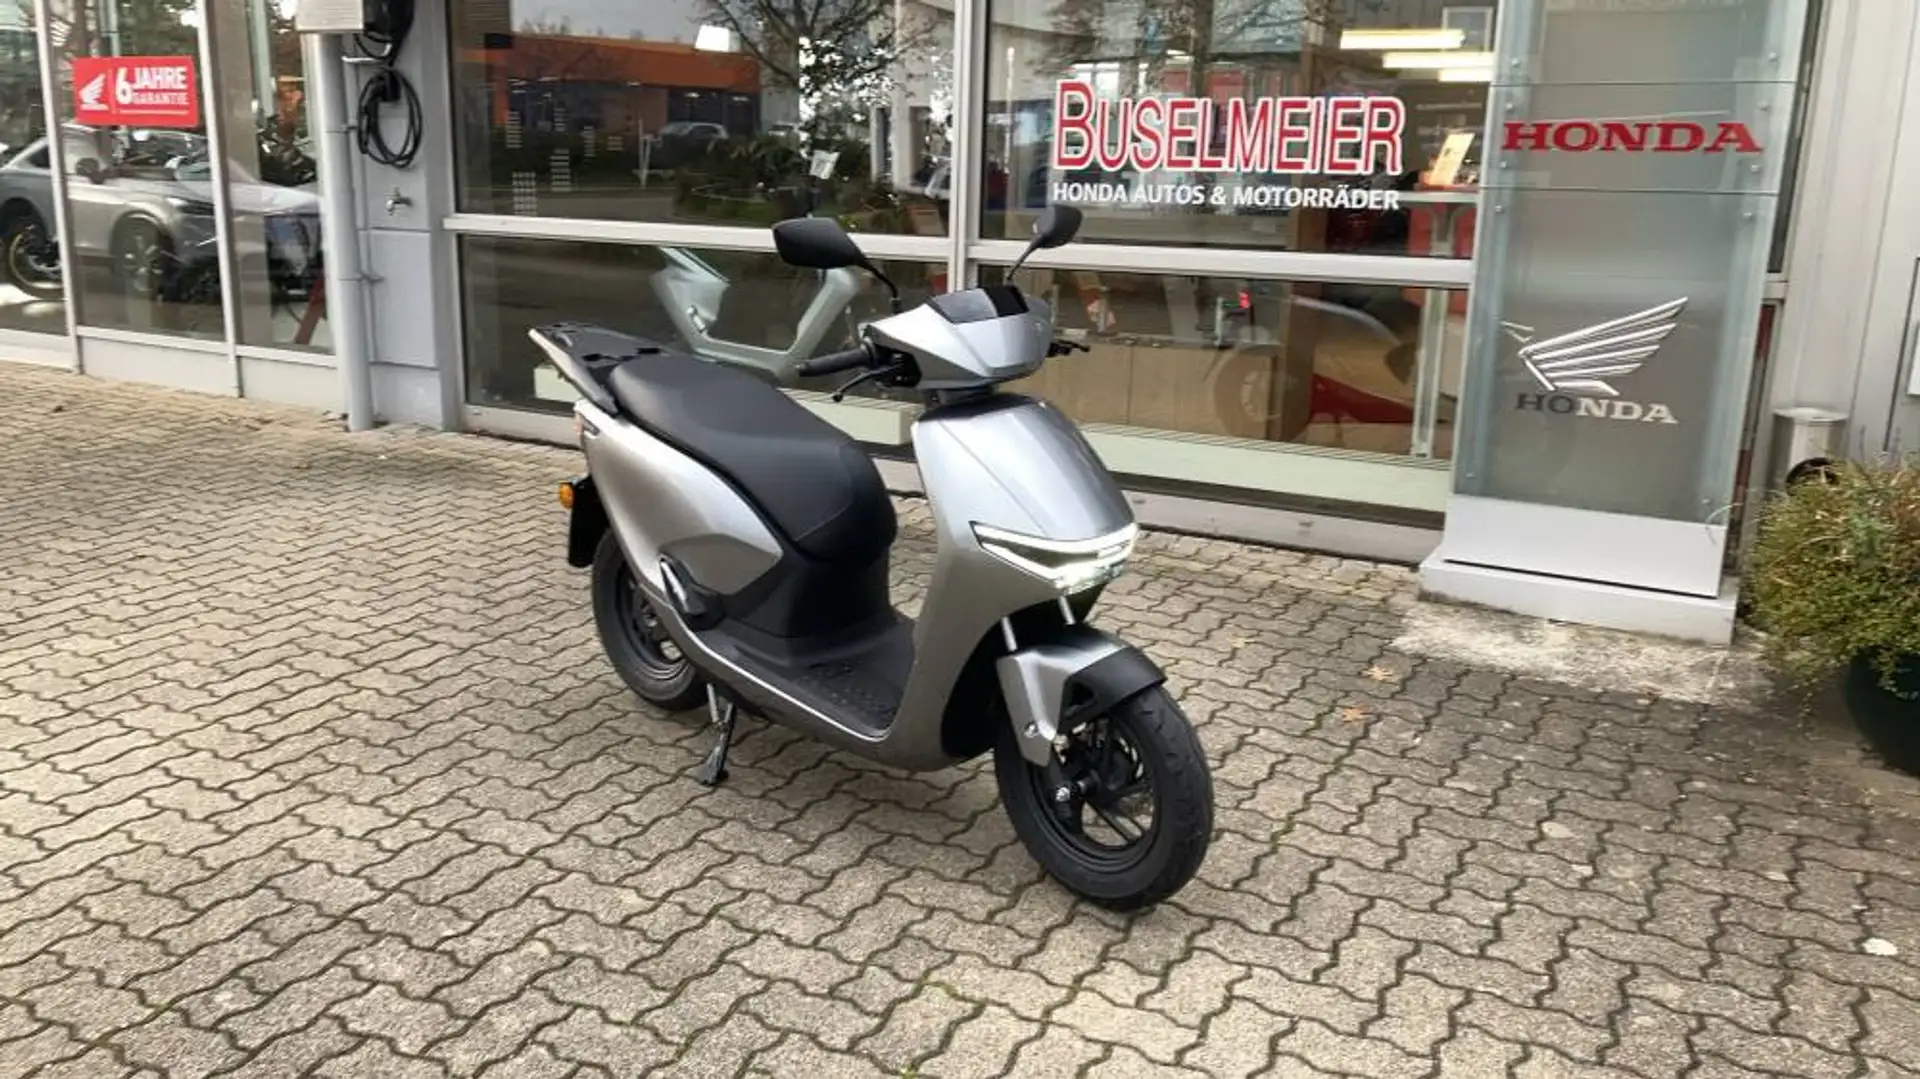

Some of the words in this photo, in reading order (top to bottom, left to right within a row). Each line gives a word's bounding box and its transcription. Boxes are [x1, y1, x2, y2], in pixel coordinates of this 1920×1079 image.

[115, 66, 133, 105] 6
[133, 66, 188, 89] JAHRE
[1053, 79, 1406, 176] BUSELMEIER
[1503, 121, 1765, 154] HONDA
[1053, 182, 1129, 202] HONDA
[1131, 184, 1205, 205] AUTOS
[1210, 186, 1227, 205] &
[1233, 184, 1400, 210] MOTORRÄDER
[1516, 393, 1680, 424] HONDA
